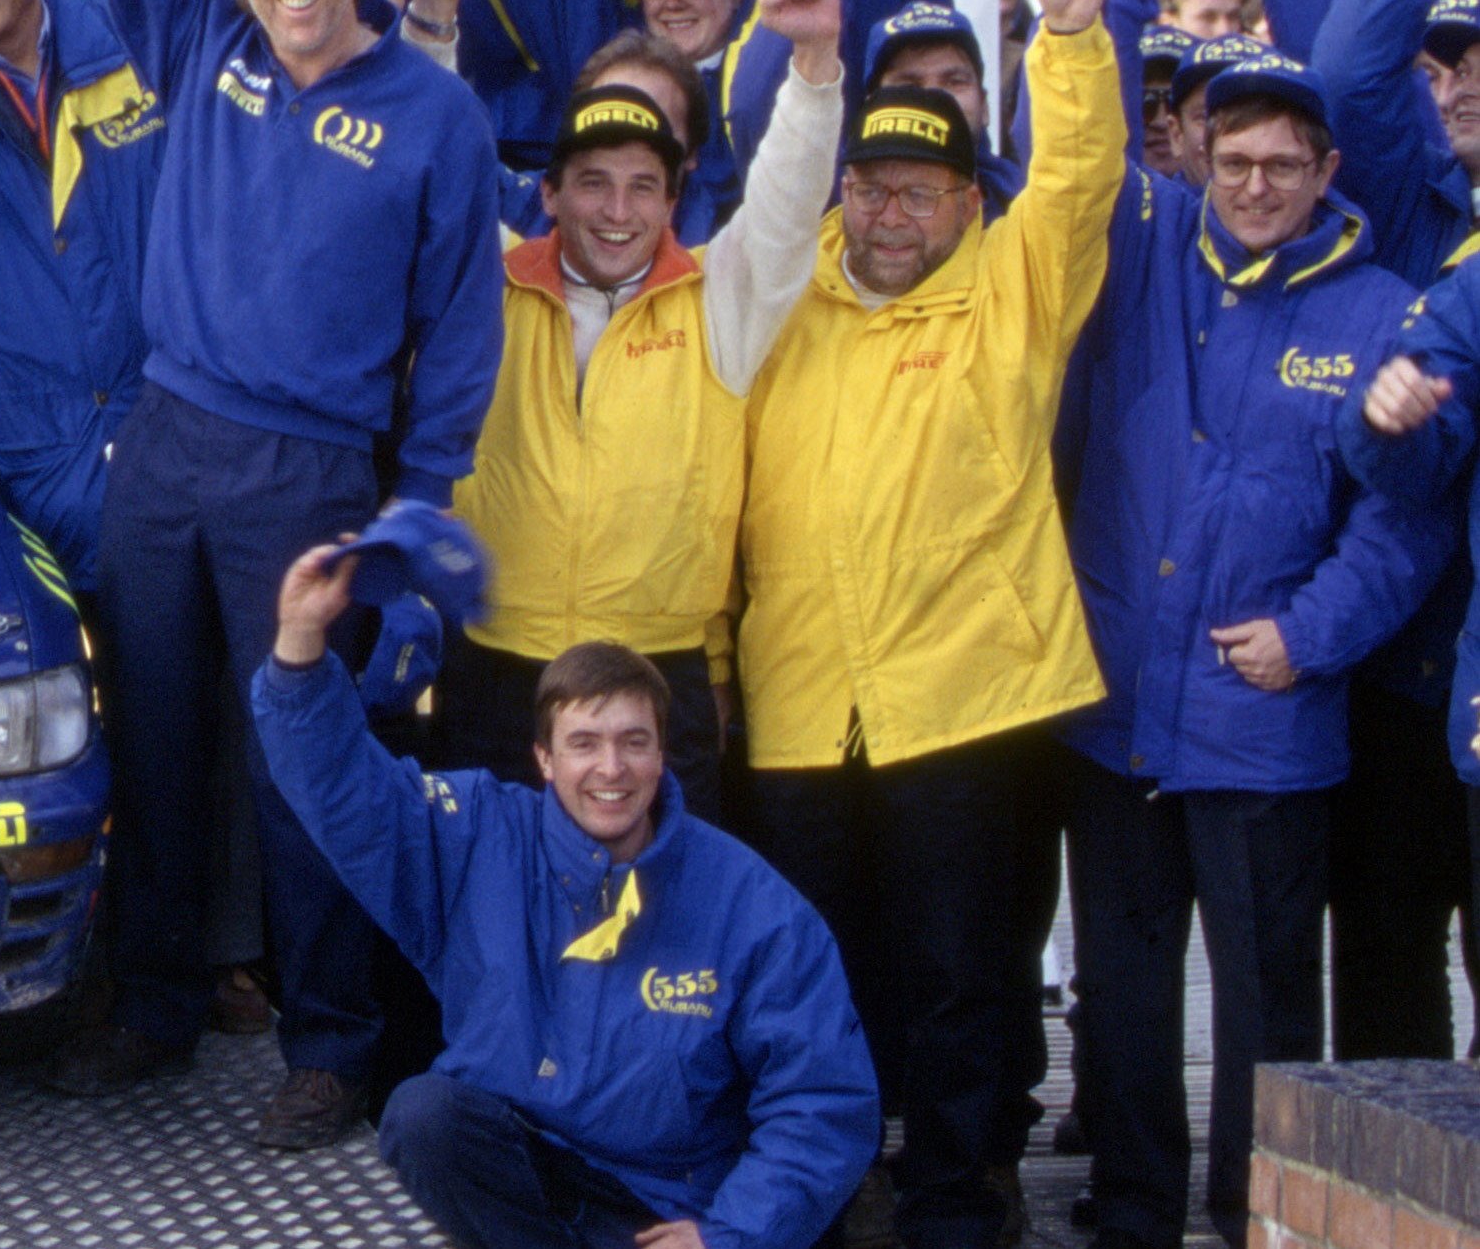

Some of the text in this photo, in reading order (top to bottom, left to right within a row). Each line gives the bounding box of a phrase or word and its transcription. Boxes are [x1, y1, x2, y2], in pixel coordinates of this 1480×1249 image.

[861, 106, 950, 147] PIRELLI
[1290, 354, 1355, 379] 555
[653, 969, 719, 1002] 555
